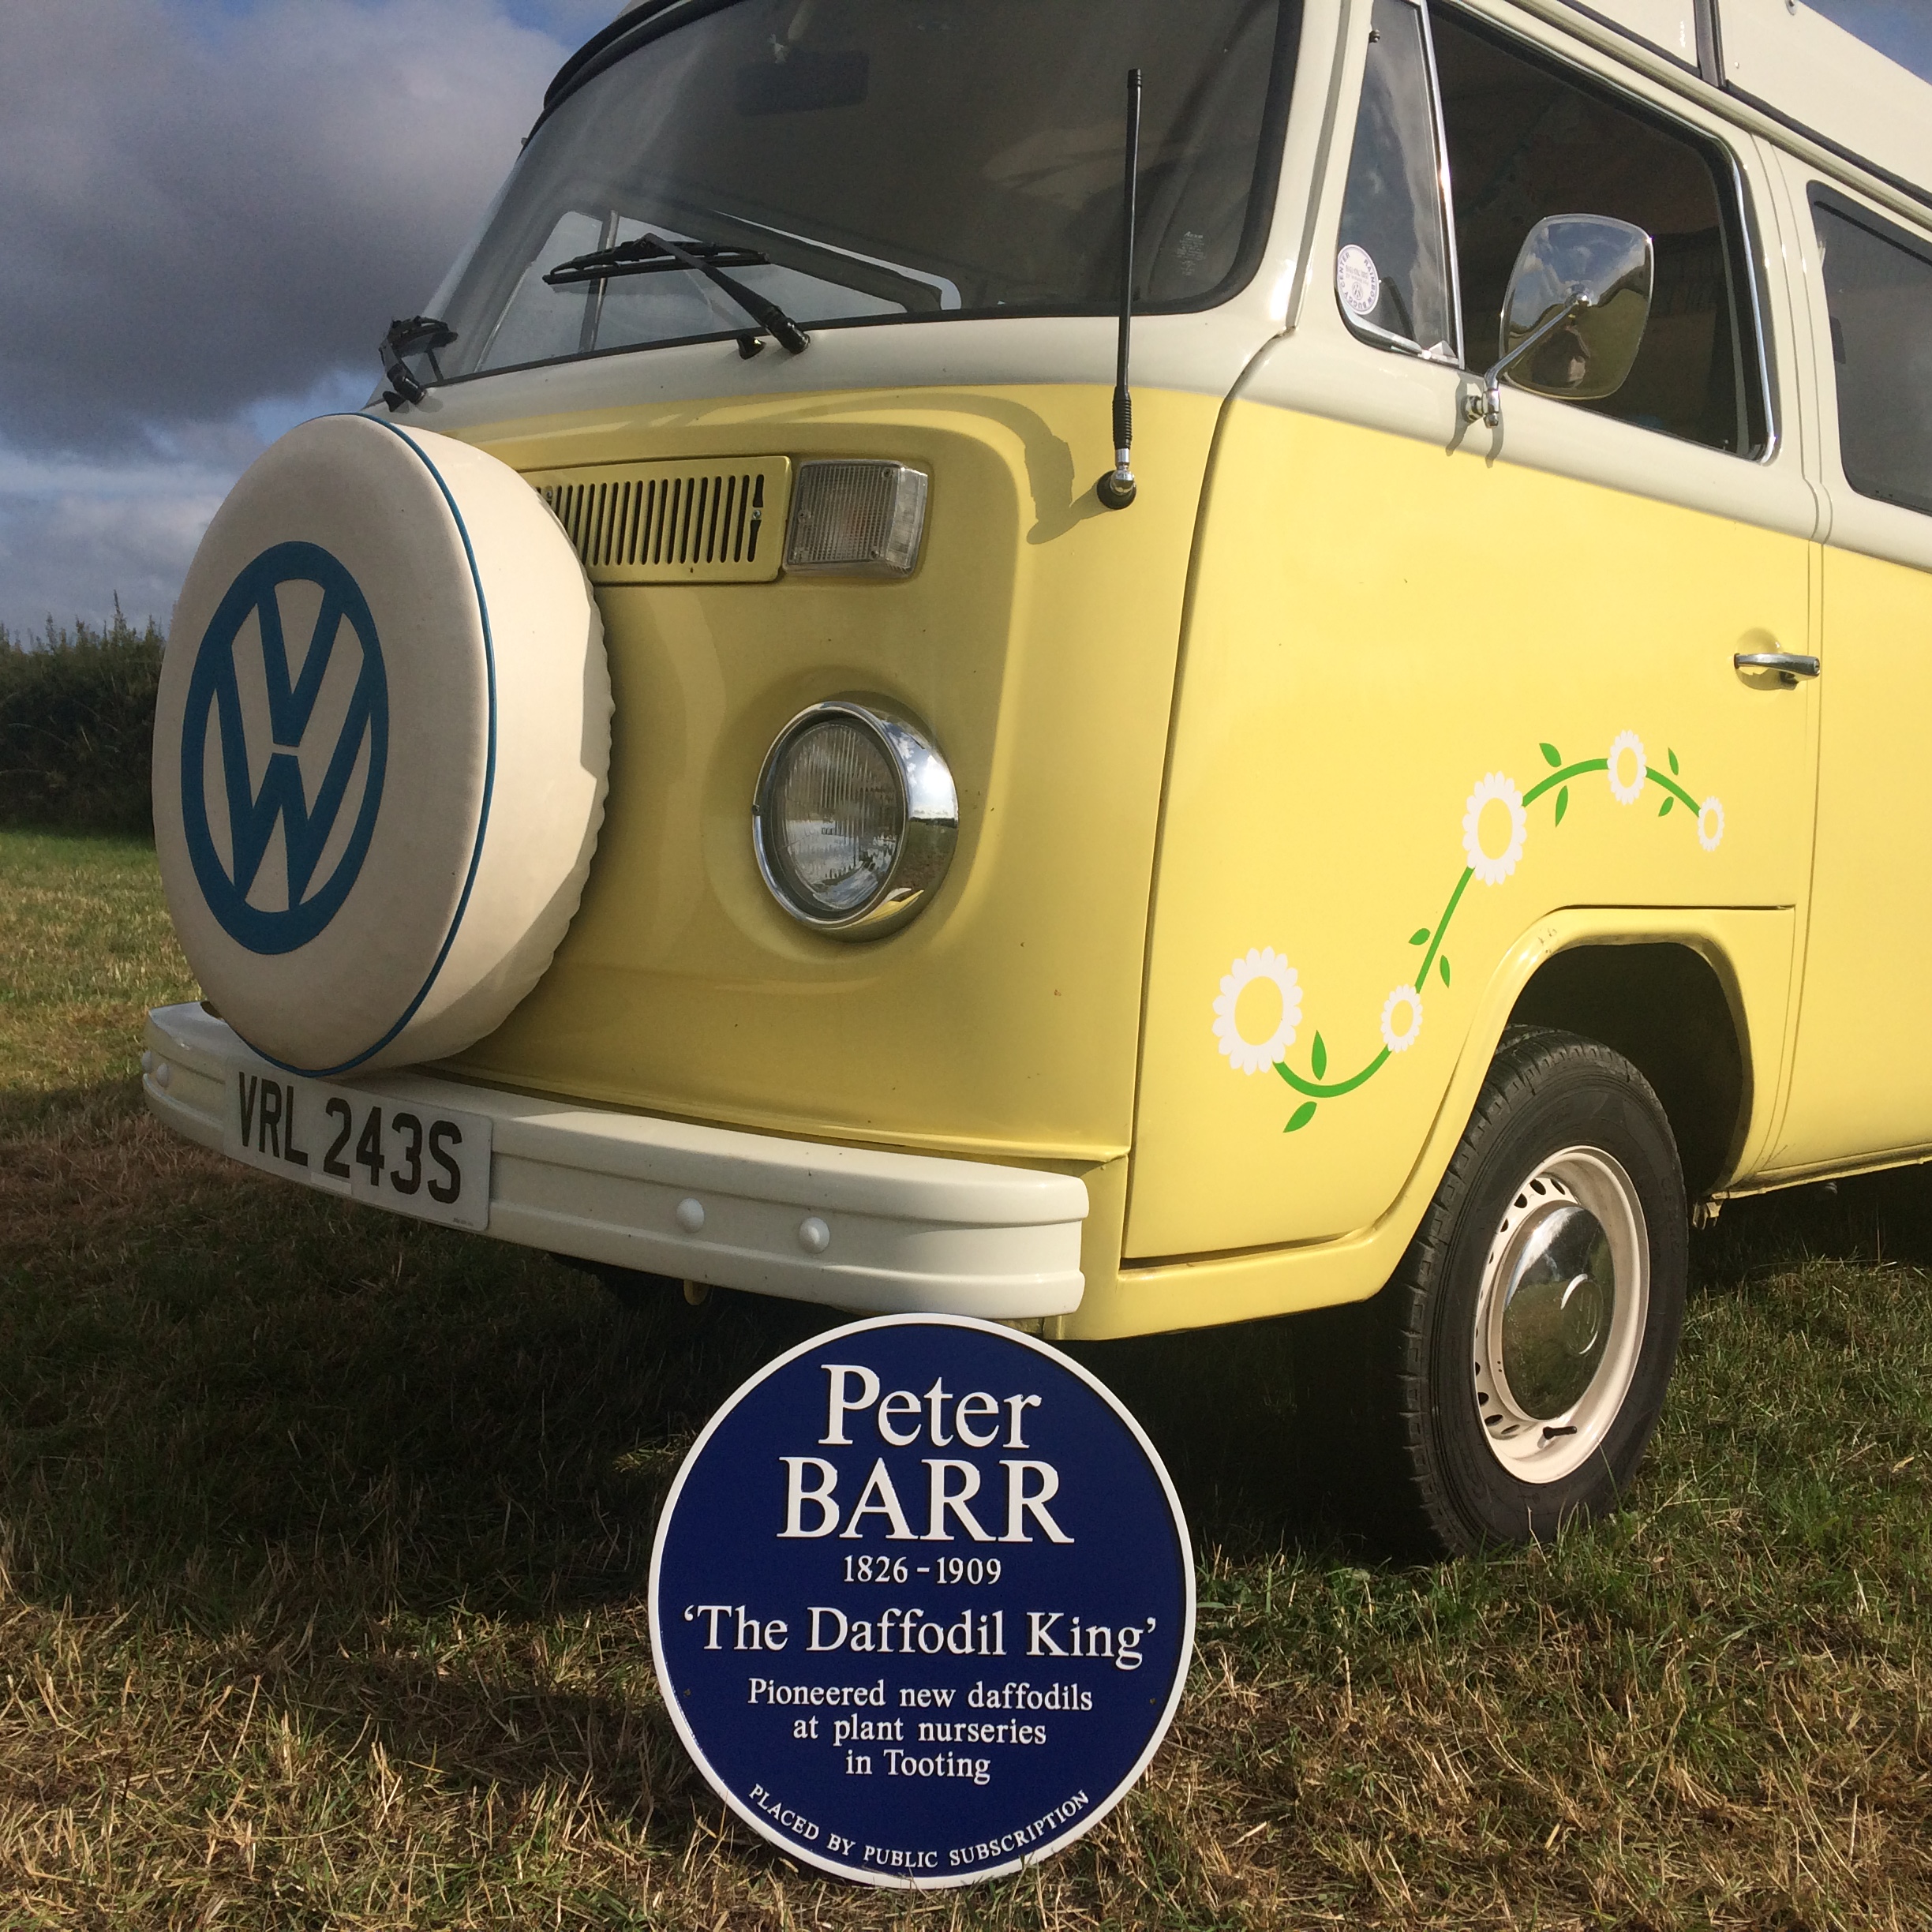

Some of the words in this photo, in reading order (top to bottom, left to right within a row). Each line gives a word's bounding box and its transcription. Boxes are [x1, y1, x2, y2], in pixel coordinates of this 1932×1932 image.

[1339, 251, 1350, 288] CENTER
[188, 559, 386, 935] VW
[239, 1071, 309, 1167] VRL
[323, 1096, 462, 1204] 243S
[818, 1364, 1043, 1449] Peter
[776, 1456, 1075, 1544] BARR
[806, 1607, 1007, 1656] Daffodil
[747, 1678, 886, 1706] Pioneered
[899, 1688, 957, 1708] new
[968, 1680, 1093, 1711] daffodils
[793, 1715, 819, 1739] at
[833, 1713, 904, 1747] plant
[918, 1718, 1046, 1745] nurseries
[845, 1749, 873, 1775] in
[883, 1749, 991, 1785] Tooting
[747, 1783, 820, 1841] PLACED
[826, 1833, 856, 1857] BY
[863, 1844, 939, 1869] PUBLIC
[949, 1789, 1091, 1867] SUBSCRIPTION
